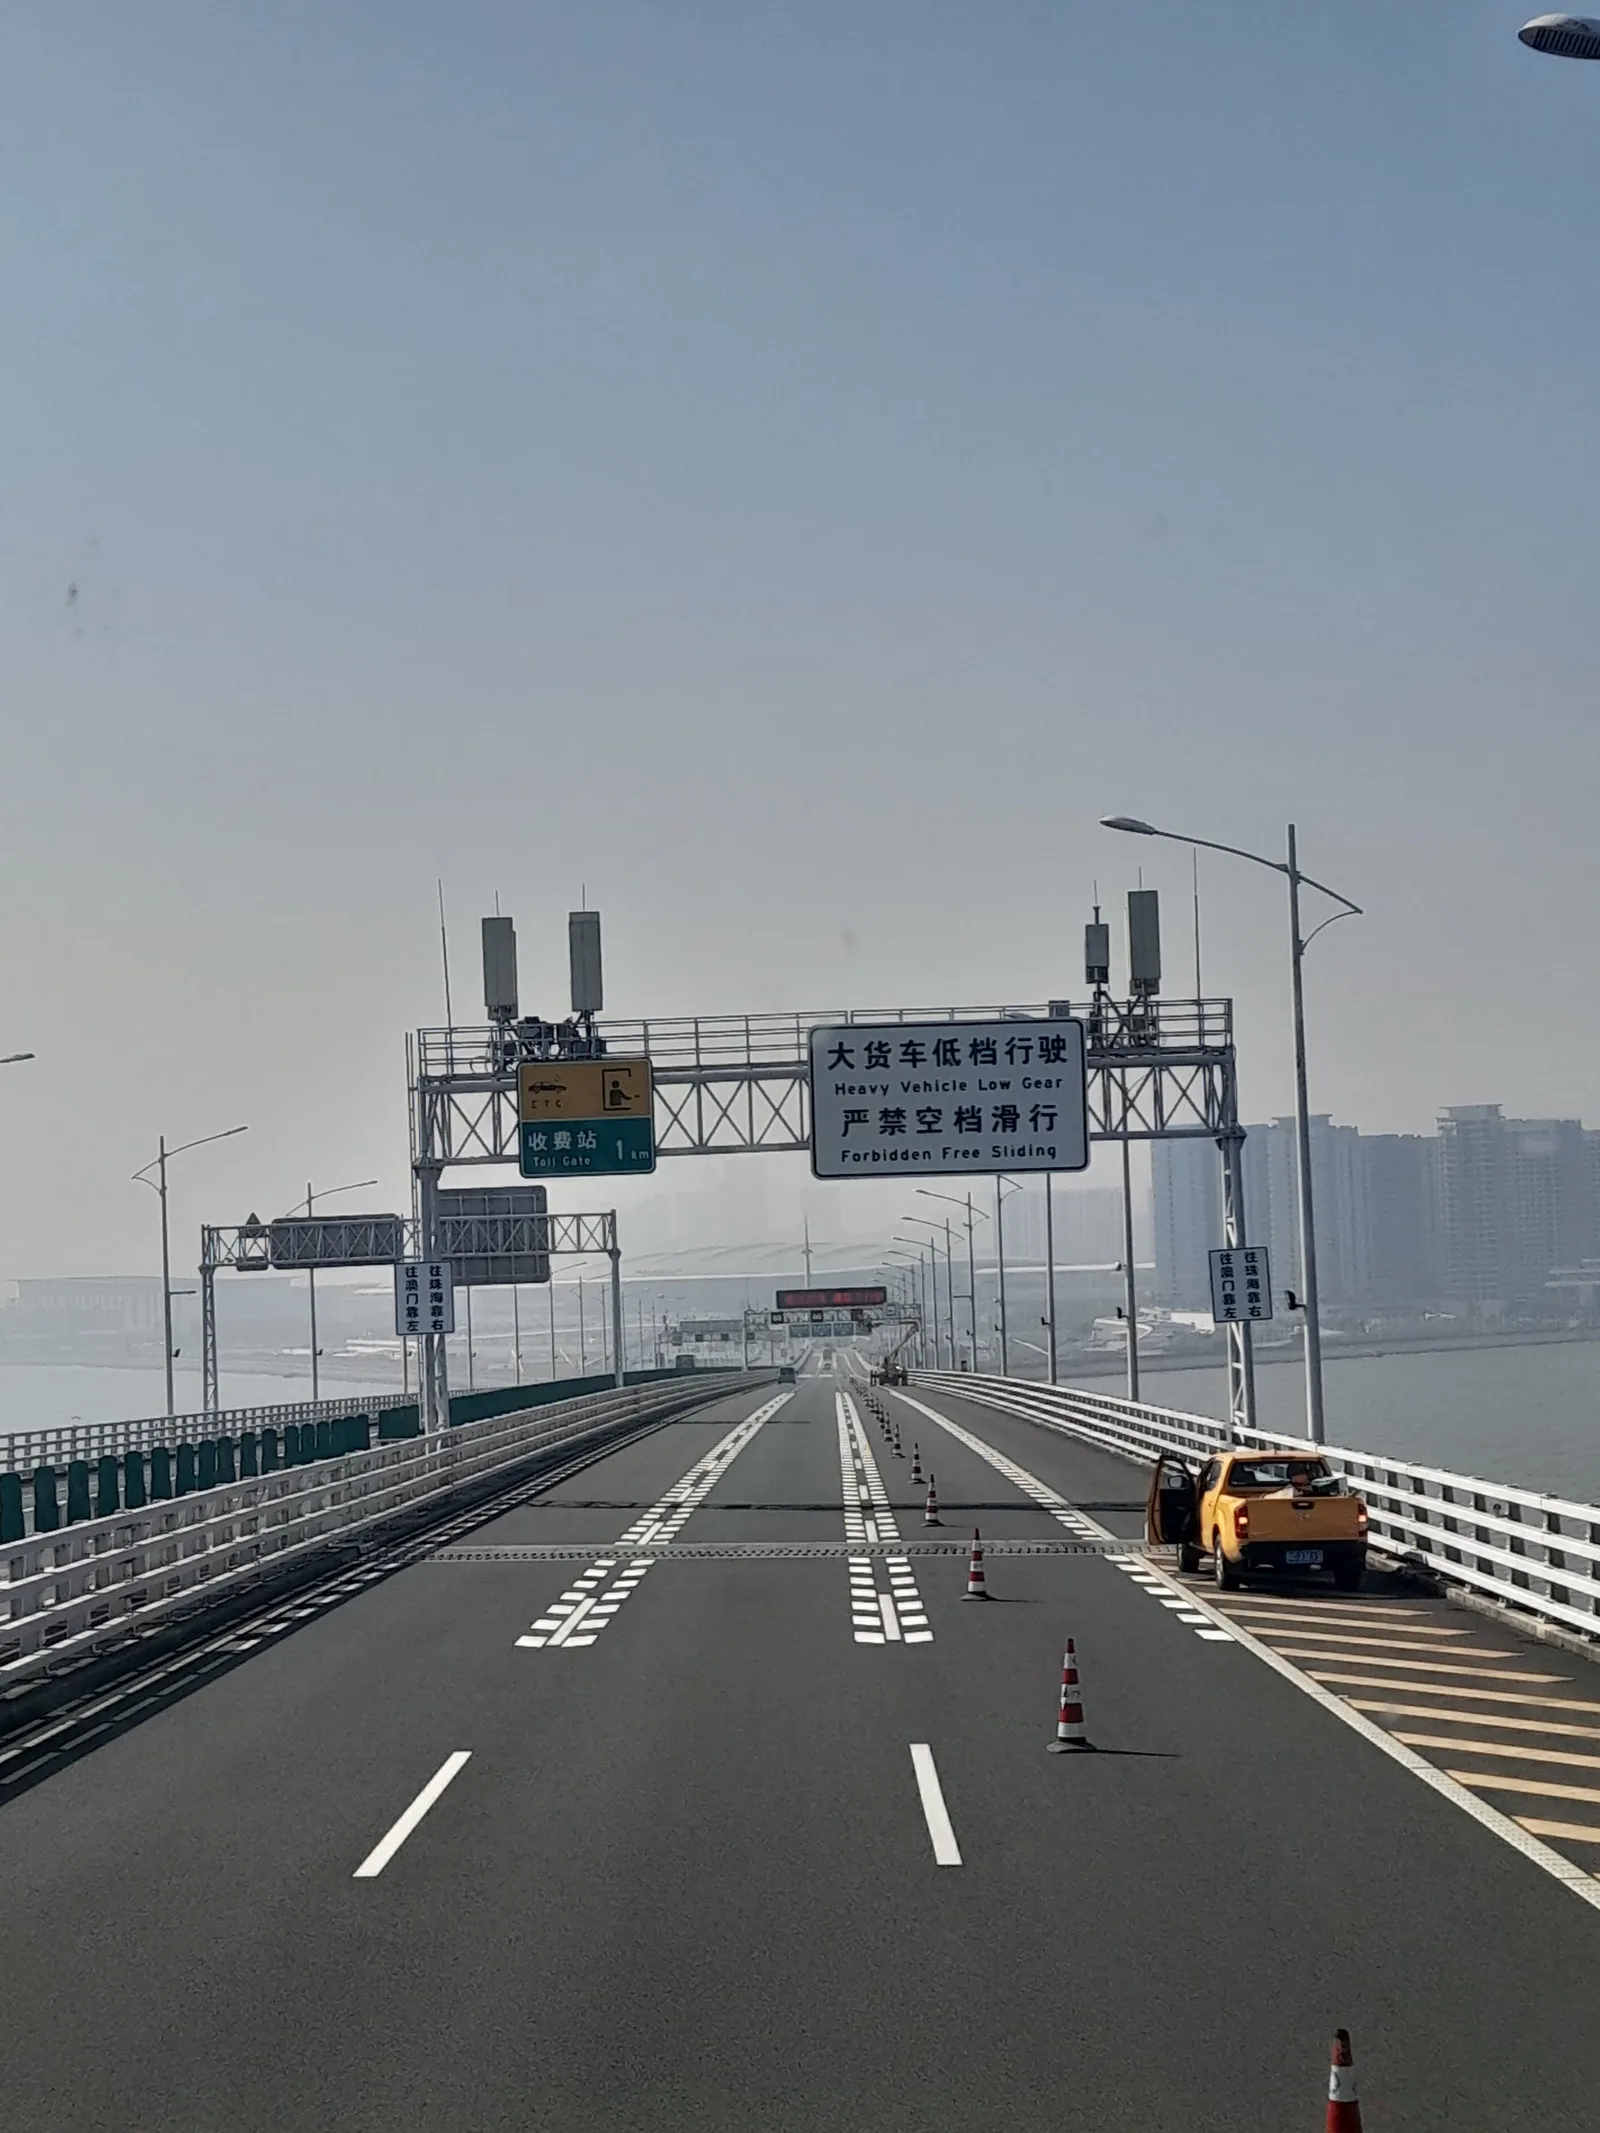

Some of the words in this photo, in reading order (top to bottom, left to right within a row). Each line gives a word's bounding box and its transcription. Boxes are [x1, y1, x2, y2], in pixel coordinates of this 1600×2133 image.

[827, 1033, 1068, 1071] 大货车低档行驶
[835, 1082, 890, 1097] Heavy
[901, 1078, 967, 1094] Vehicle
[978, 1078, 1011, 1091] Low
[1022, 1077, 1063, 1090] Gear
[841, 1104, 1058, 1137] 严禁空档滑行
[528, 1130, 597, 1152] 收费站
[615, 1139, 623, 1160] 1
[631, 1150, 649, 1160] km
[533, 1157, 556, 1168] Toll
[562, 1156, 591, 1167] Gate
[841, 1148, 932, 1163] Forbidden
[942, 1146, 980, 1160] Free
[992, 1144, 1057, 1160] Sliding
